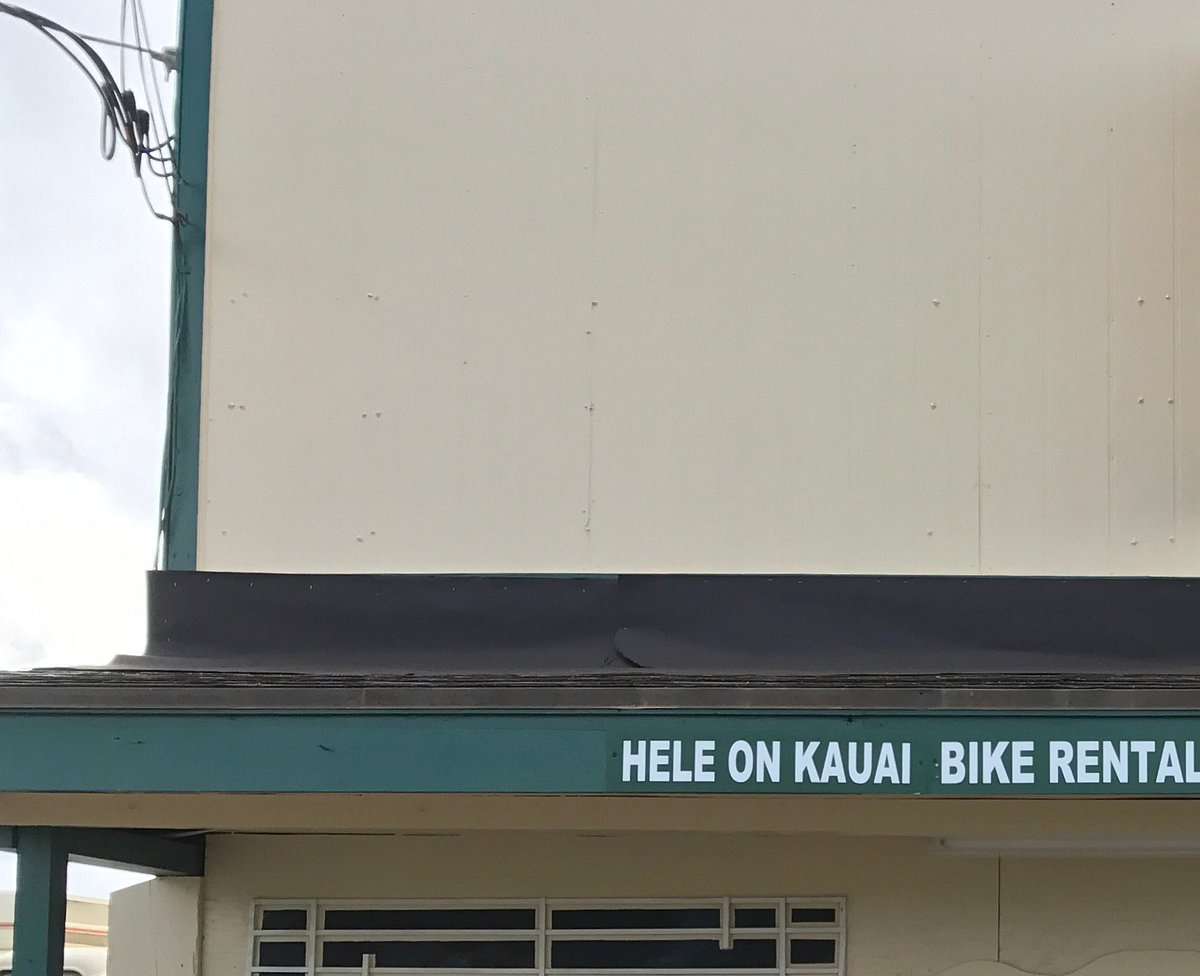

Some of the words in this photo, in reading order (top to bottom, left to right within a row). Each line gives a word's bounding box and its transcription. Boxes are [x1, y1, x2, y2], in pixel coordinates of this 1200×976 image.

[621, 740, 716, 782] HELE
[728, 740, 781, 783] ON
[795, 741, 911, 784] KAUAI
[941, 741, 1035, 784] BIKE
